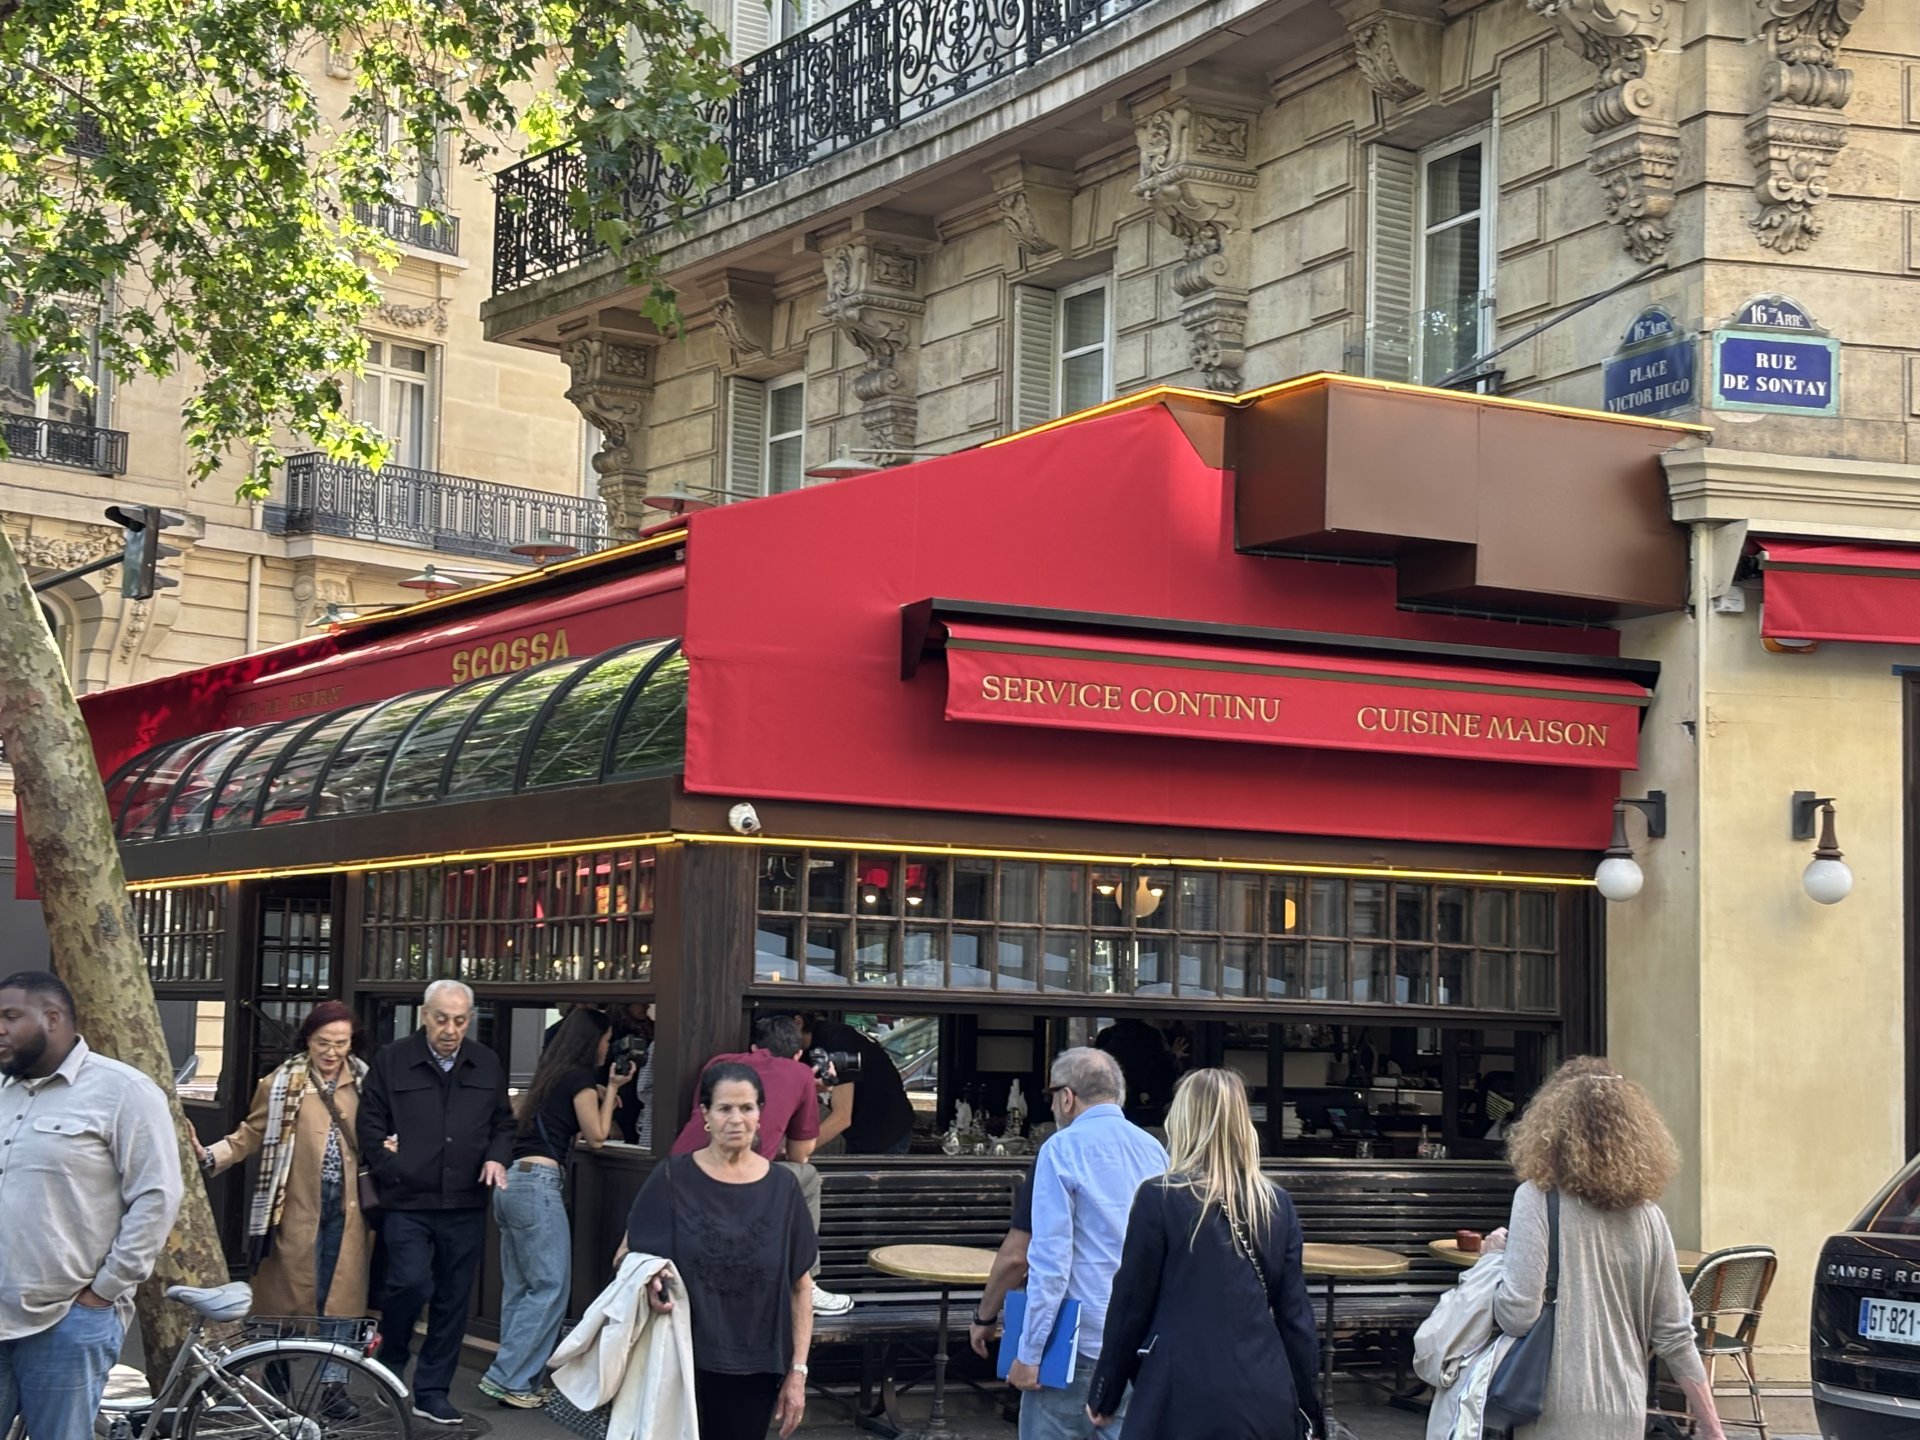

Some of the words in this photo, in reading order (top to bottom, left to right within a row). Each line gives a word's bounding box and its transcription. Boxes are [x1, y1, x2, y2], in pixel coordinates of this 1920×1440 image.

[1629, 360, 1667, 385] PLACE
[1756, 352, 1797, 370] RUE
[1608, 388, 1653, 413] VICTOR
[1655, 378, 1690, 401] HUGO
[1723, 374, 1750, 391] DE
[1755, 376, 1828, 396] SONTAY
[452, 628, 570, 683] SCOSSA
[981, 675, 1122, 711] SERVICE
[1130, 687, 1281, 722] CONTINU
[1356, 706, 1481, 738] CUISINE
[1486, 716, 1609, 747] MAISON
[1828, 1264, 1882, 1280] RANGE
